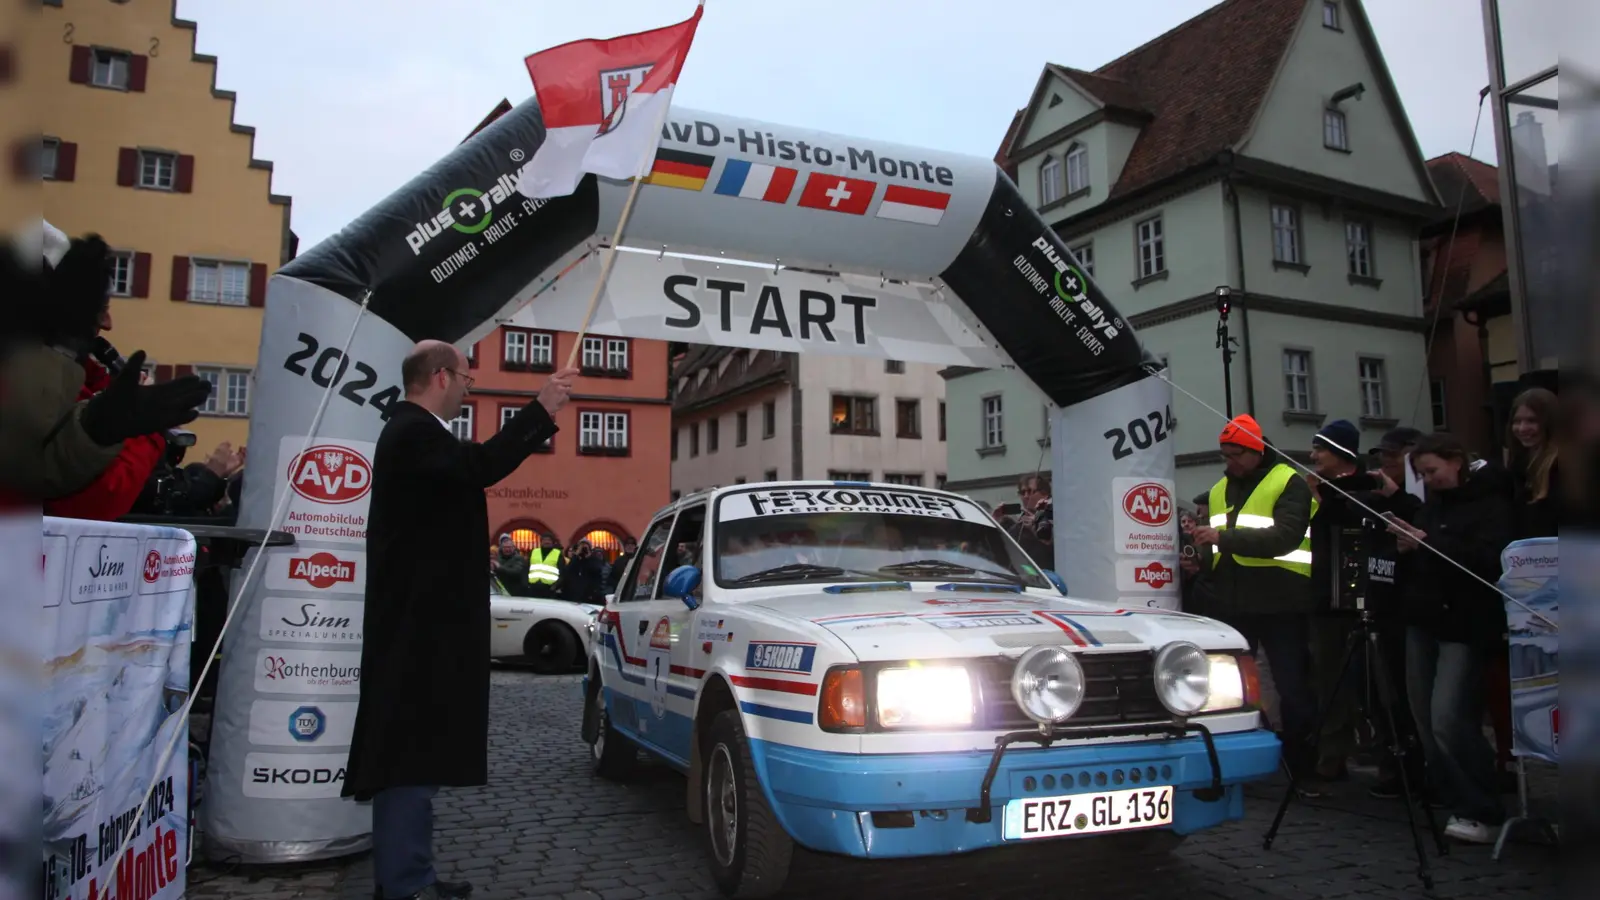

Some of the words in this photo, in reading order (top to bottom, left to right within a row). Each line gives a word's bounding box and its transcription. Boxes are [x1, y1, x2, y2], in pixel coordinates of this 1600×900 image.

[479, 168, 525, 214] rally
[430, 241, 480, 284] OLDTIMER
[483, 212, 519, 245] RALLYE
[662, 274, 877, 345] START
[1013, 254, 1049, 295] OLDTIMER
[1048, 295, 1077, 326] RALLYE
[1075, 326, 1105, 356] EVENTS
[283, 332, 402, 423] 2024
[1103, 404, 1177, 461] 2024
[485, 487, 569, 500] eschenkehaus
[748, 490, 966, 521] HERKOMMER
[288, 511, 365, 526] Automobilclub
[771, 506, 952, 518] PERFORMANCE
[283, 525, 301, 534] von
[89, 545, 124, 578] Sinn
[294, 561, 350, 580] Alpecin
[1139, 570, 1171, 583] Alpecin
[281, 603, 350, 628] Sinn
[269, 630, 362, 640] SPEZIALUHREN
[264, 655, 360, 681] Rothenburg
[1024, 799, 1071, 834] ERZ
[1092, 795, 1121, 826] GL
[1128, 789, 1169, 823] 136
[98, 804, 144, 867] Februar
